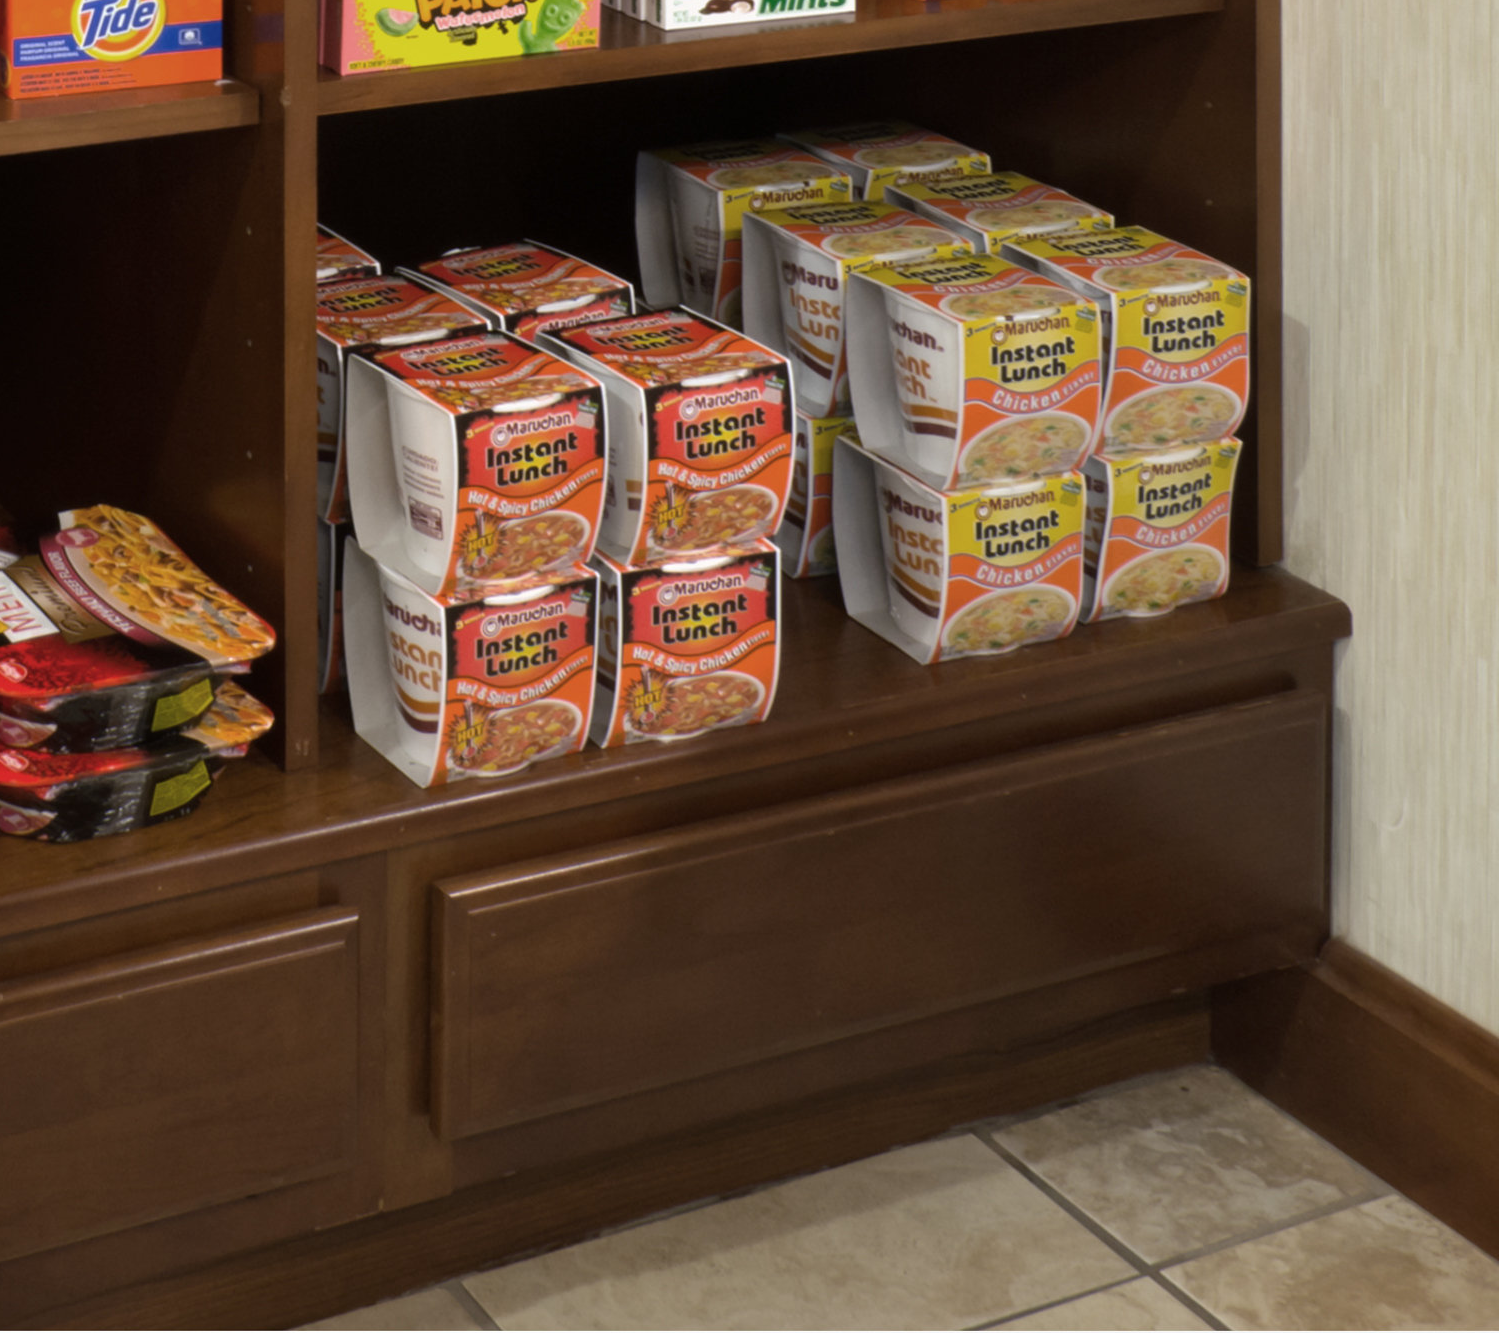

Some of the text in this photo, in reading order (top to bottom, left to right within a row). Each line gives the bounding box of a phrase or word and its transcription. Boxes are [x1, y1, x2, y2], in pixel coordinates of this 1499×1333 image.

[434, 2, 527, 32] Watermelon
[1156, 289, 1221, 310] Maruchan
[1003, 314, 1071, 336] Maruchan
[1142, 309, 1226, 336] Instant
[991, 336, 1076, 366] Instant
[1151, 329, 1217, 354] Lunch
[1000, 357, 1068, 384] Lunch
[991, 389, 1061, 413] Chicken
[505, 411, 572, 435] Maruchan
[485, 432, 579, 469] Instant
[495, 457, 568, 487] Lunch
[467, 481, 577, 517] Hot & Spicy Chicken
